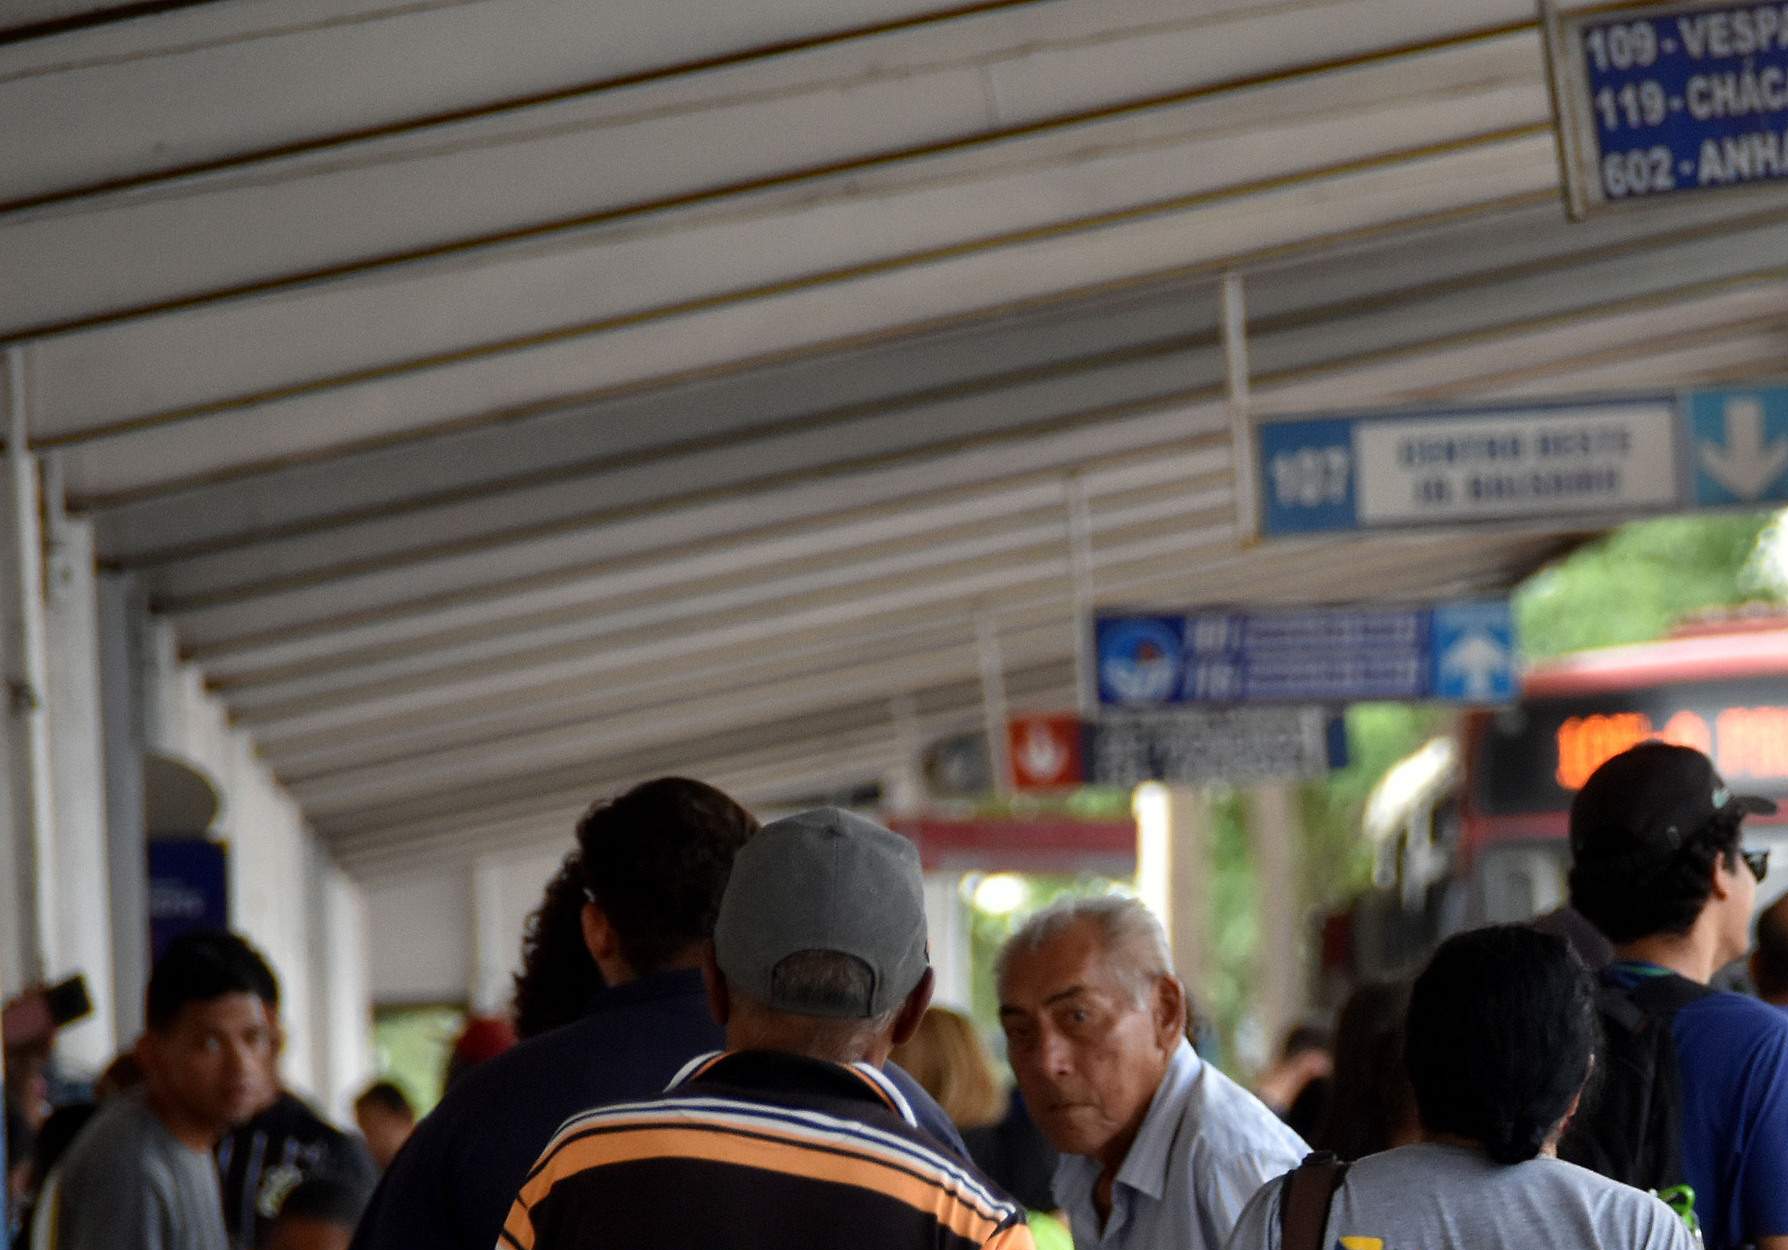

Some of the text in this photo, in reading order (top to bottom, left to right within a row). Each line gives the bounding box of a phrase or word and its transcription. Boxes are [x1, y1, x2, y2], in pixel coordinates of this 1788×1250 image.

[1588, 20, 1658, 71] 109
[1597, 79, 1667, 131] 119
[1604, 145, 1677, 197] 602
